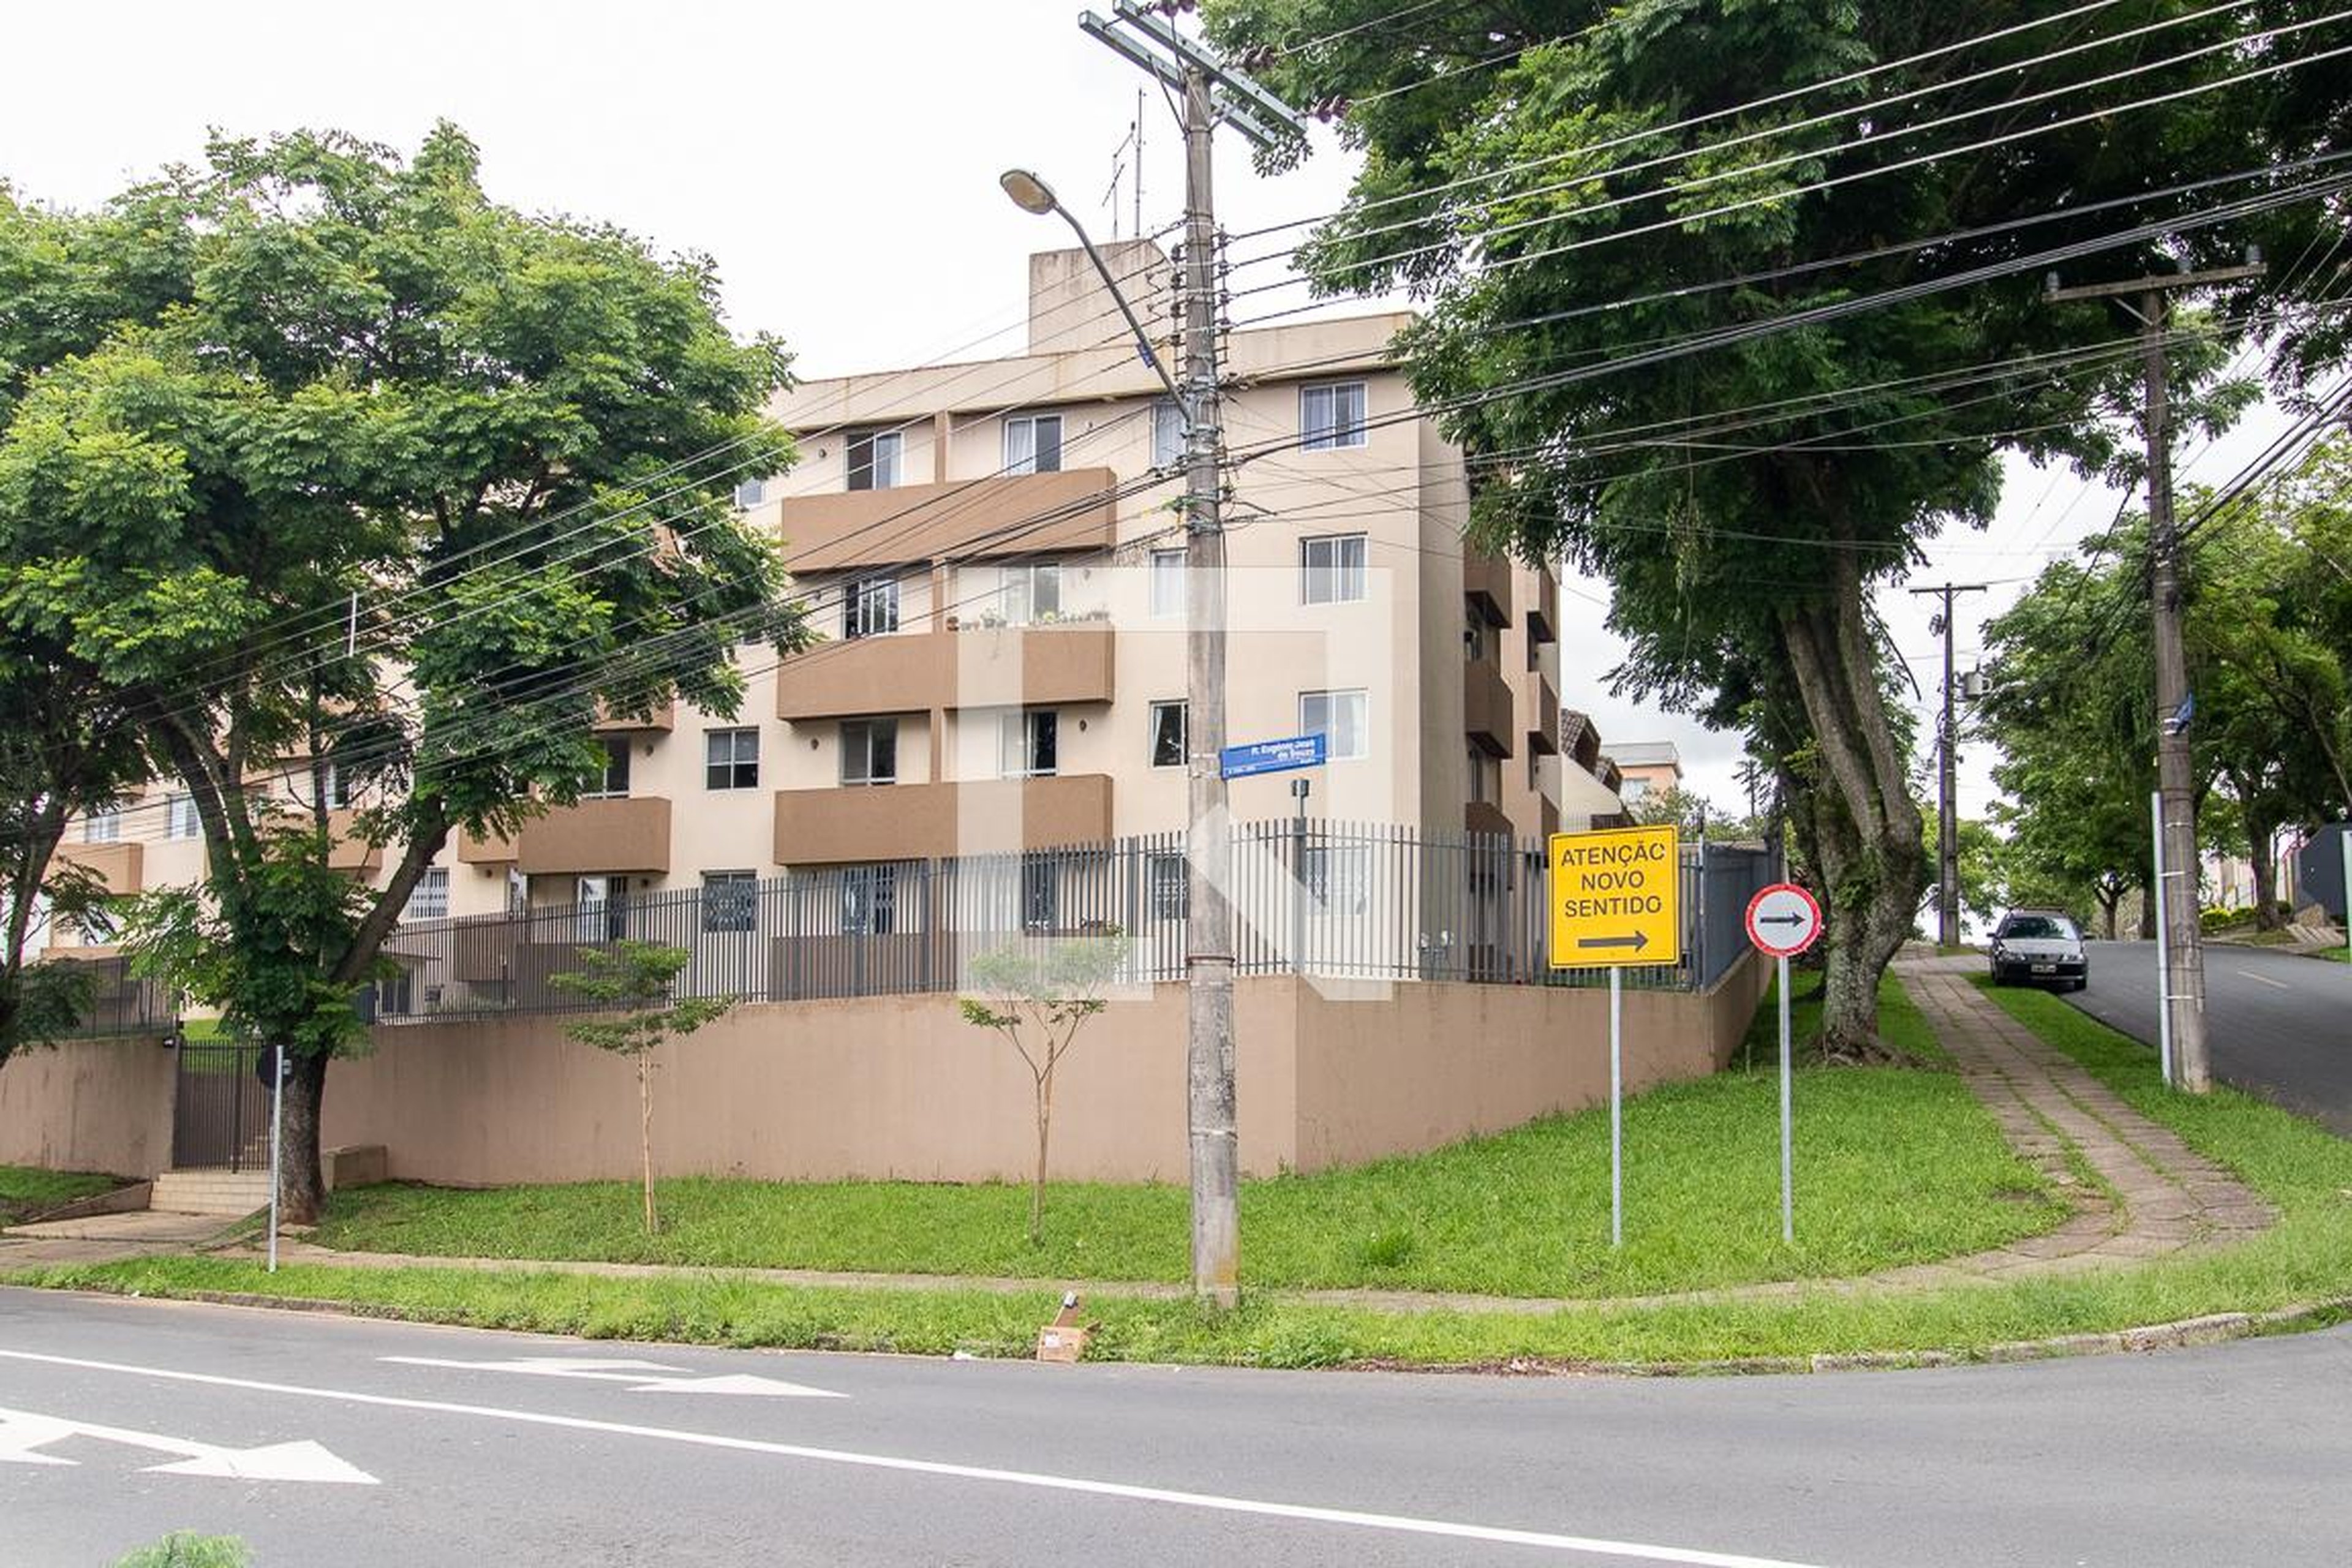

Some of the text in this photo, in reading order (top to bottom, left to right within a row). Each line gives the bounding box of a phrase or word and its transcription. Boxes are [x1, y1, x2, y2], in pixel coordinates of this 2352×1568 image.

[1561, 840, 1667, 867] ATENÇÃO
[1581, 870, 1645, 891] NOVO
[1564, 895, 1662, 918] SENTIDO
